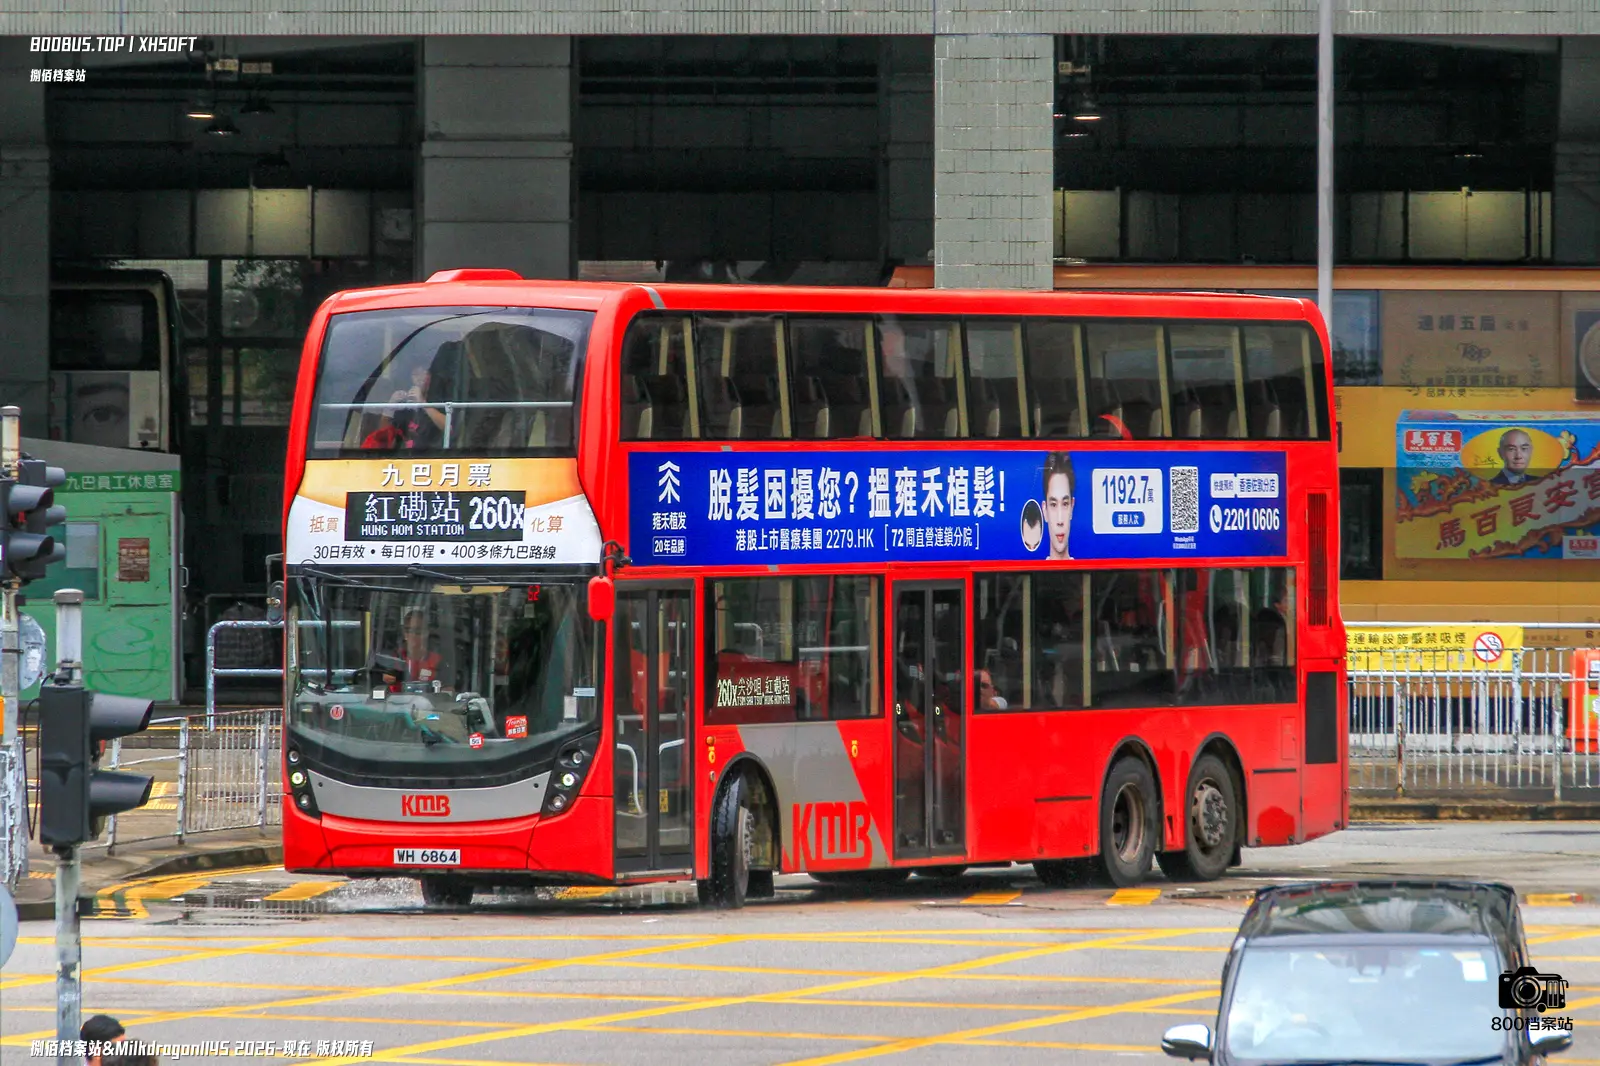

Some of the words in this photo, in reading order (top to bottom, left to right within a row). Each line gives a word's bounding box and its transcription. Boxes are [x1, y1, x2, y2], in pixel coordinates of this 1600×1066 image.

[1410, 431, 1456, 447] 馬百良
[66, 474, 173, 490] 九巴員工休息室
[380, 463, 493, 488] 九巴月票
[365, 491, 460, 523] 紅磡站
[308, 514, 339, 533] 抵買
[361, 524, 388, 536] HUNG
[391, 524, 413, 536] HOM
[416, 524, 465, 536] STATION
[530, 514, 564, 533] 化算
[654, 538, 685, 554] 20年品牌
[735, 528, 823, 551] 港股上市醫療集團
[826, 528, 875, 549] 2279.HK
[313, 545, 365, 560] 30日有效
[380, 545, 435, 560] 每日10程
[451, 544, 557, 560] 400多條九巴路線
[401, 794, 451, 817] KMB
[792, 801, 873, 872] KMB
[397, 850, 415, 863] WH
[420, 850, 457, 863] 6864
